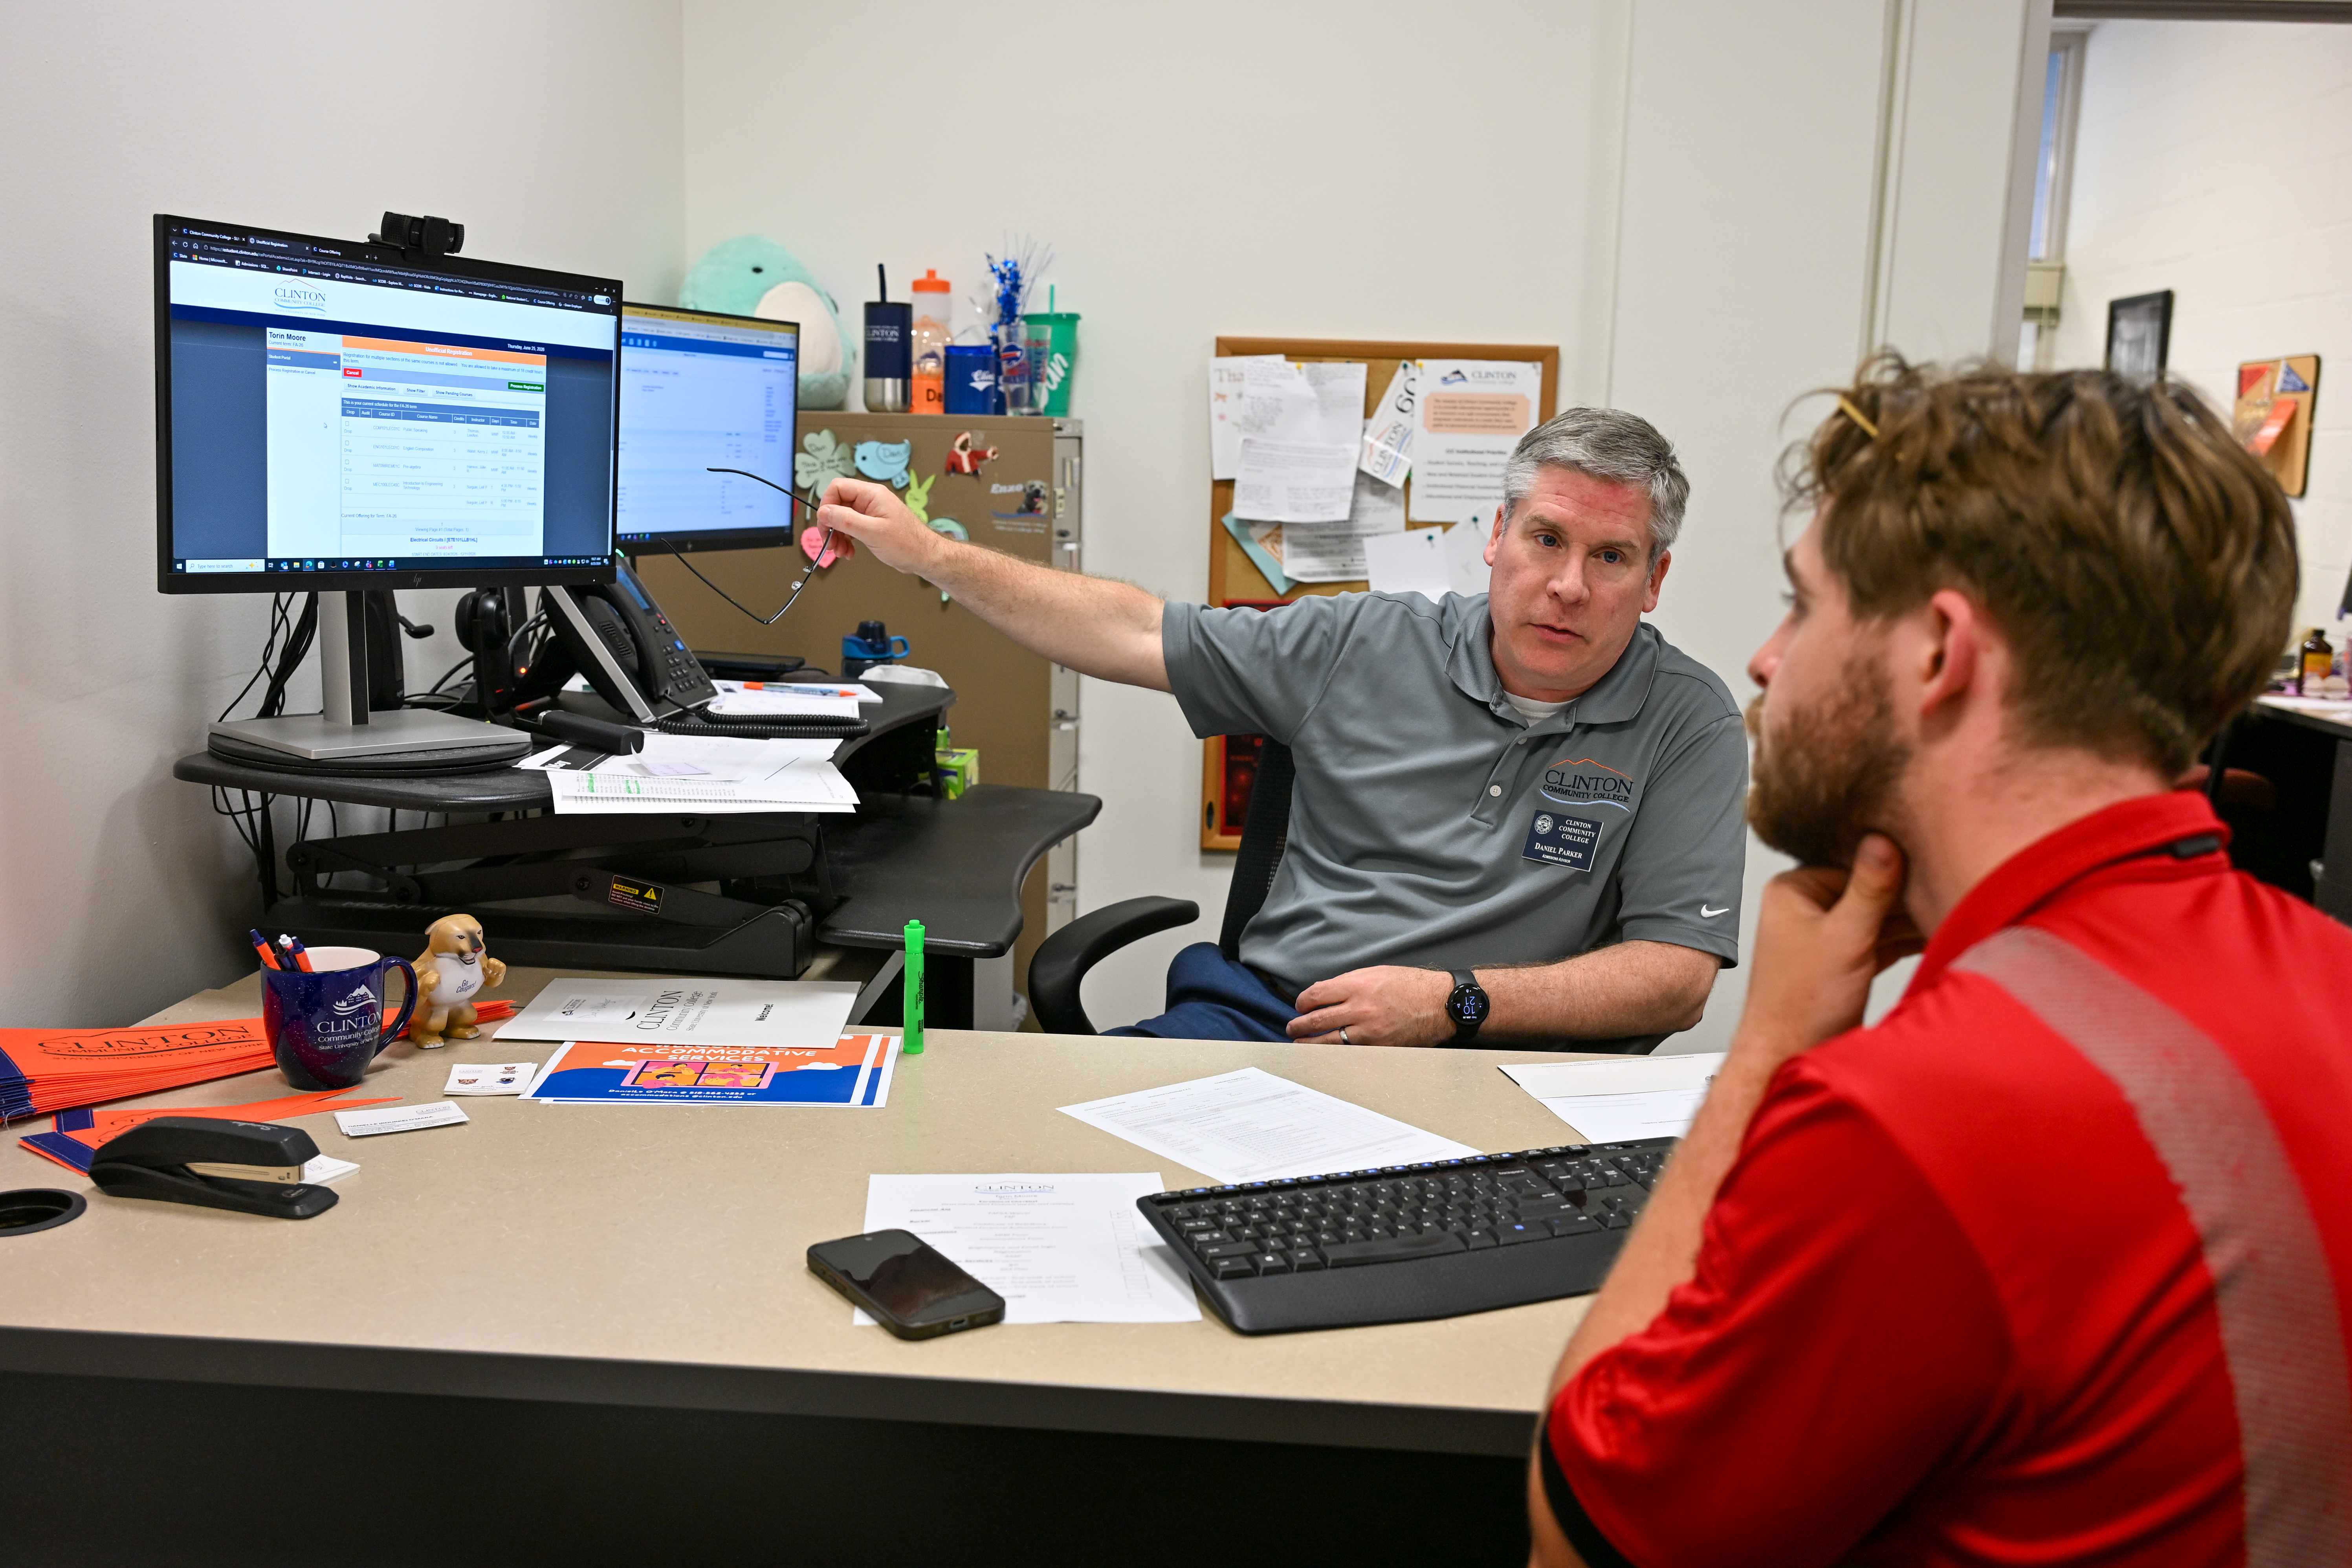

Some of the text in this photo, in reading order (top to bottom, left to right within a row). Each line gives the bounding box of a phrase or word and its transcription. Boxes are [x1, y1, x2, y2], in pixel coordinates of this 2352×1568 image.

[275, 288, 325, 302] CLINTON
[1471, 370, 1516, 379] CLINTON
[544, 760, 572, 769] May
[1545, 770, 1634, 795] CLINTON
[1543, 785, 1629, 803] COMMUNITY COLLEGE
[1566, 819, 1592, 829] CLINTON
[1558, 825, 1596, 838] COMMUNITY
[1561, 833, 1589, 844] COLLEGE
[1534, 842, 1583, 859] DANIEL PARKER
[615, 884, 637, 894] WARNING
[456, 980, 477, 993] Cougars!
[1465, 996, 1475, 1005] 21
[636, 990, 684, 1030] CLINTON
[666, 991, 703, 1031] Community College
[755, 1003, 774, 1021] Welcome!
[1464, 1005, 1476, 1014] 10
[317, 1011, 381, 1033] CLINTON
[38, 1026, 250, 1049] CLINTON
[318, 1025, 381, 1042] Community College
[43, 1034, 255, 1053] COMMUNITY COLLEGE
[621, 1047, 816, 1057] ACCOMMODATIVE
[416, 1106, 451, 1115] CLINTON
